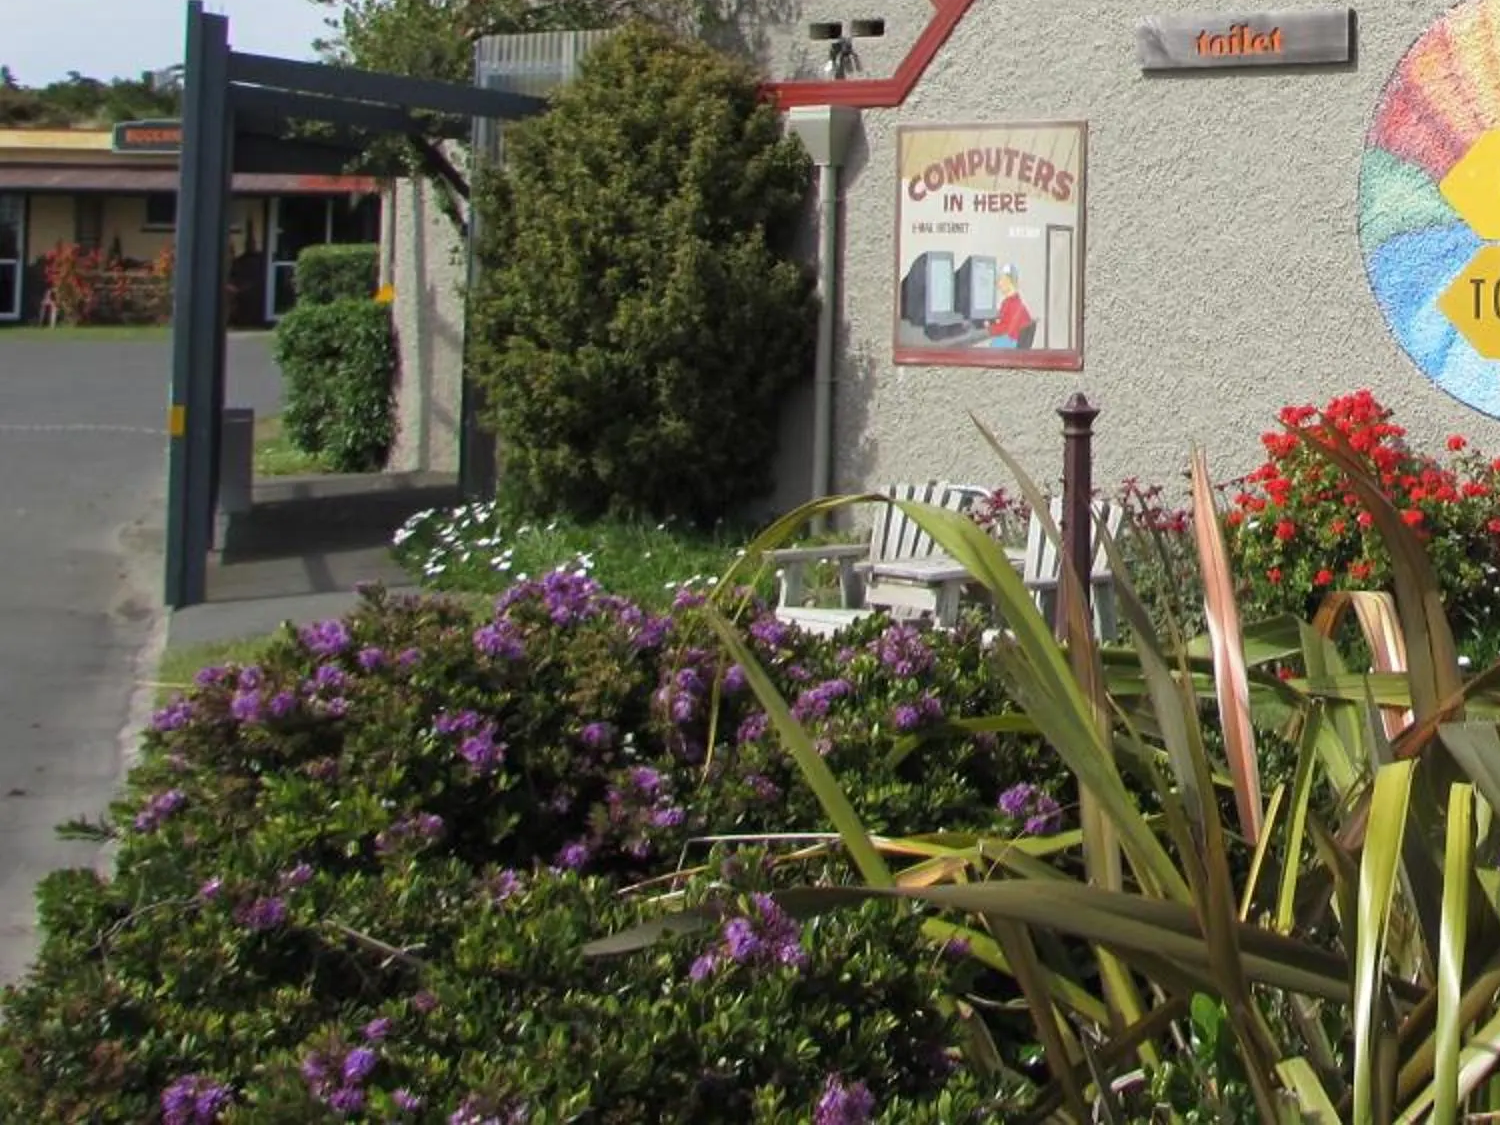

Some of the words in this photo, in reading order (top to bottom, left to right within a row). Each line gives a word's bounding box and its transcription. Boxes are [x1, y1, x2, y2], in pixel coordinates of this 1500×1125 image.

[1195, 23, 1285, 56] toilet
[908, 146, 1075, 203] COMPUTERS
[943, 193, 964, 213] IN
[973, 192, 1028, 214] HERE
